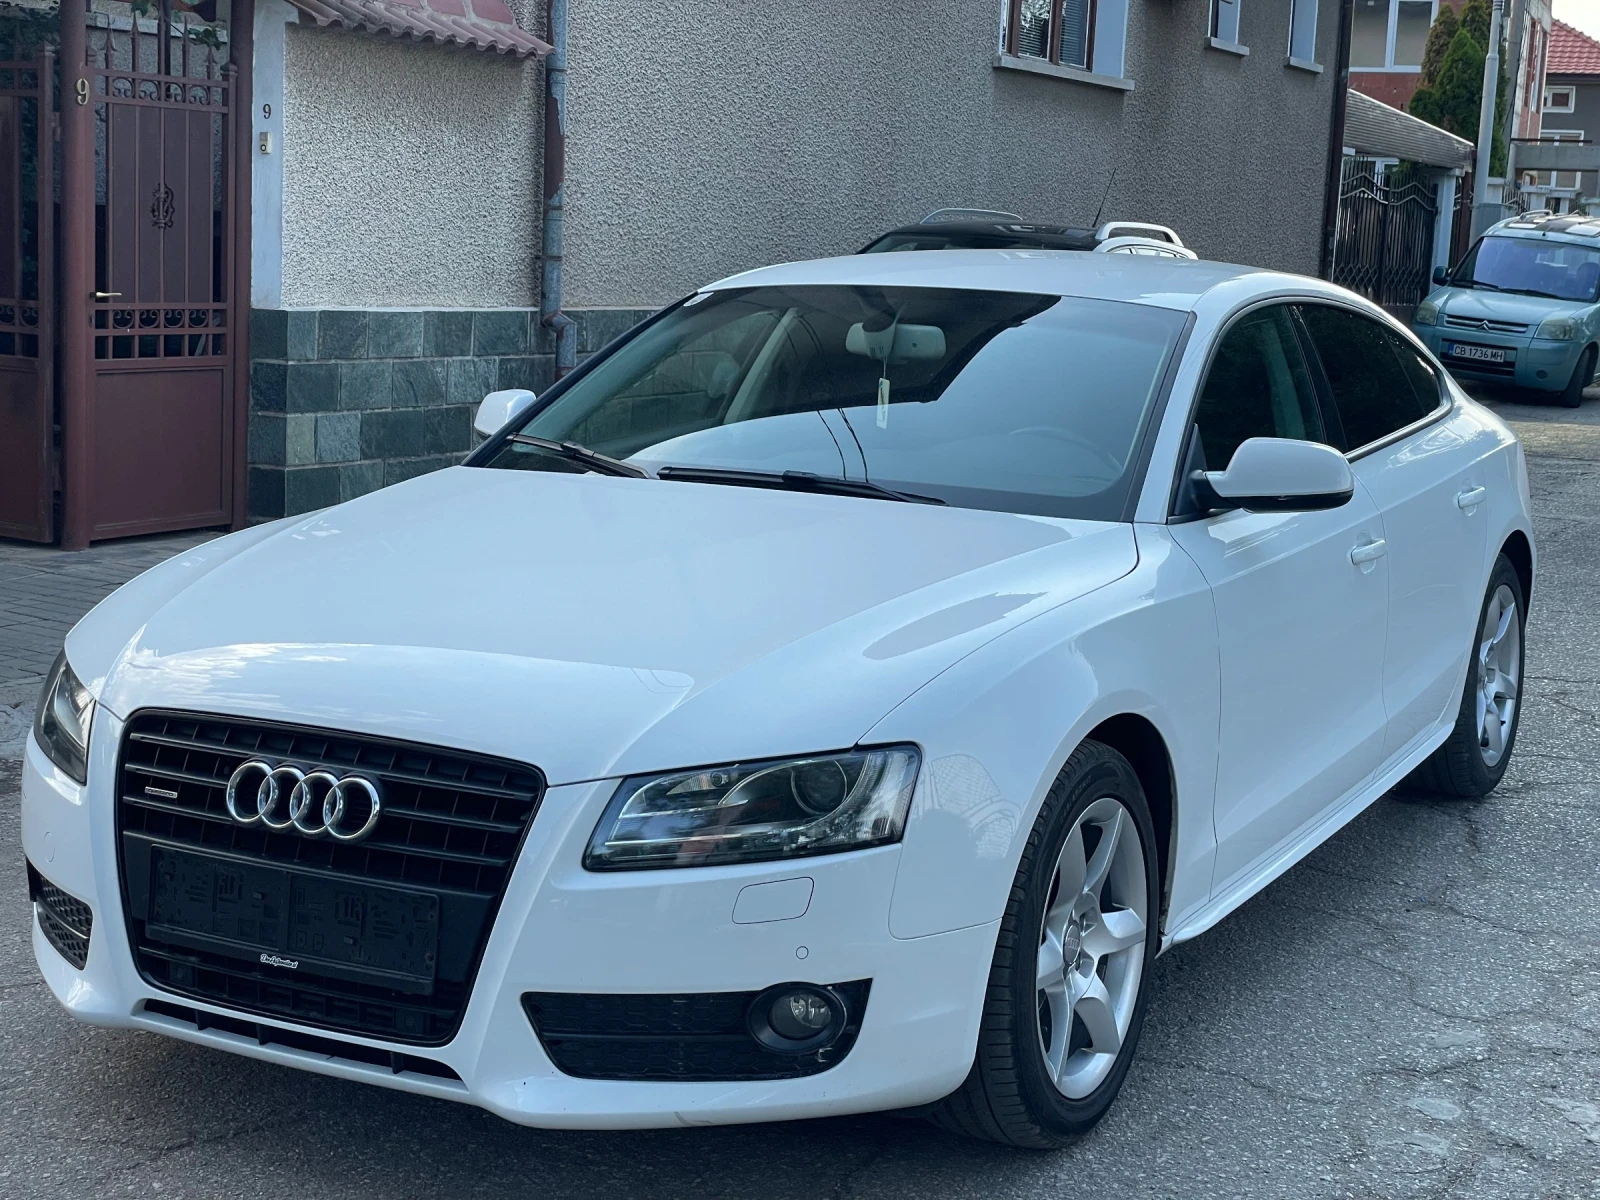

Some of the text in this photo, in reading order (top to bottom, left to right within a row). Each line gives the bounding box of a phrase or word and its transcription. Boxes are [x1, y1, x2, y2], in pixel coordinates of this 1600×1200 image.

[76, 78, 90, 105] 9
[262, 103, 272, 120] 9
[1454, 346, 1503, 361] CB 1736 MH
